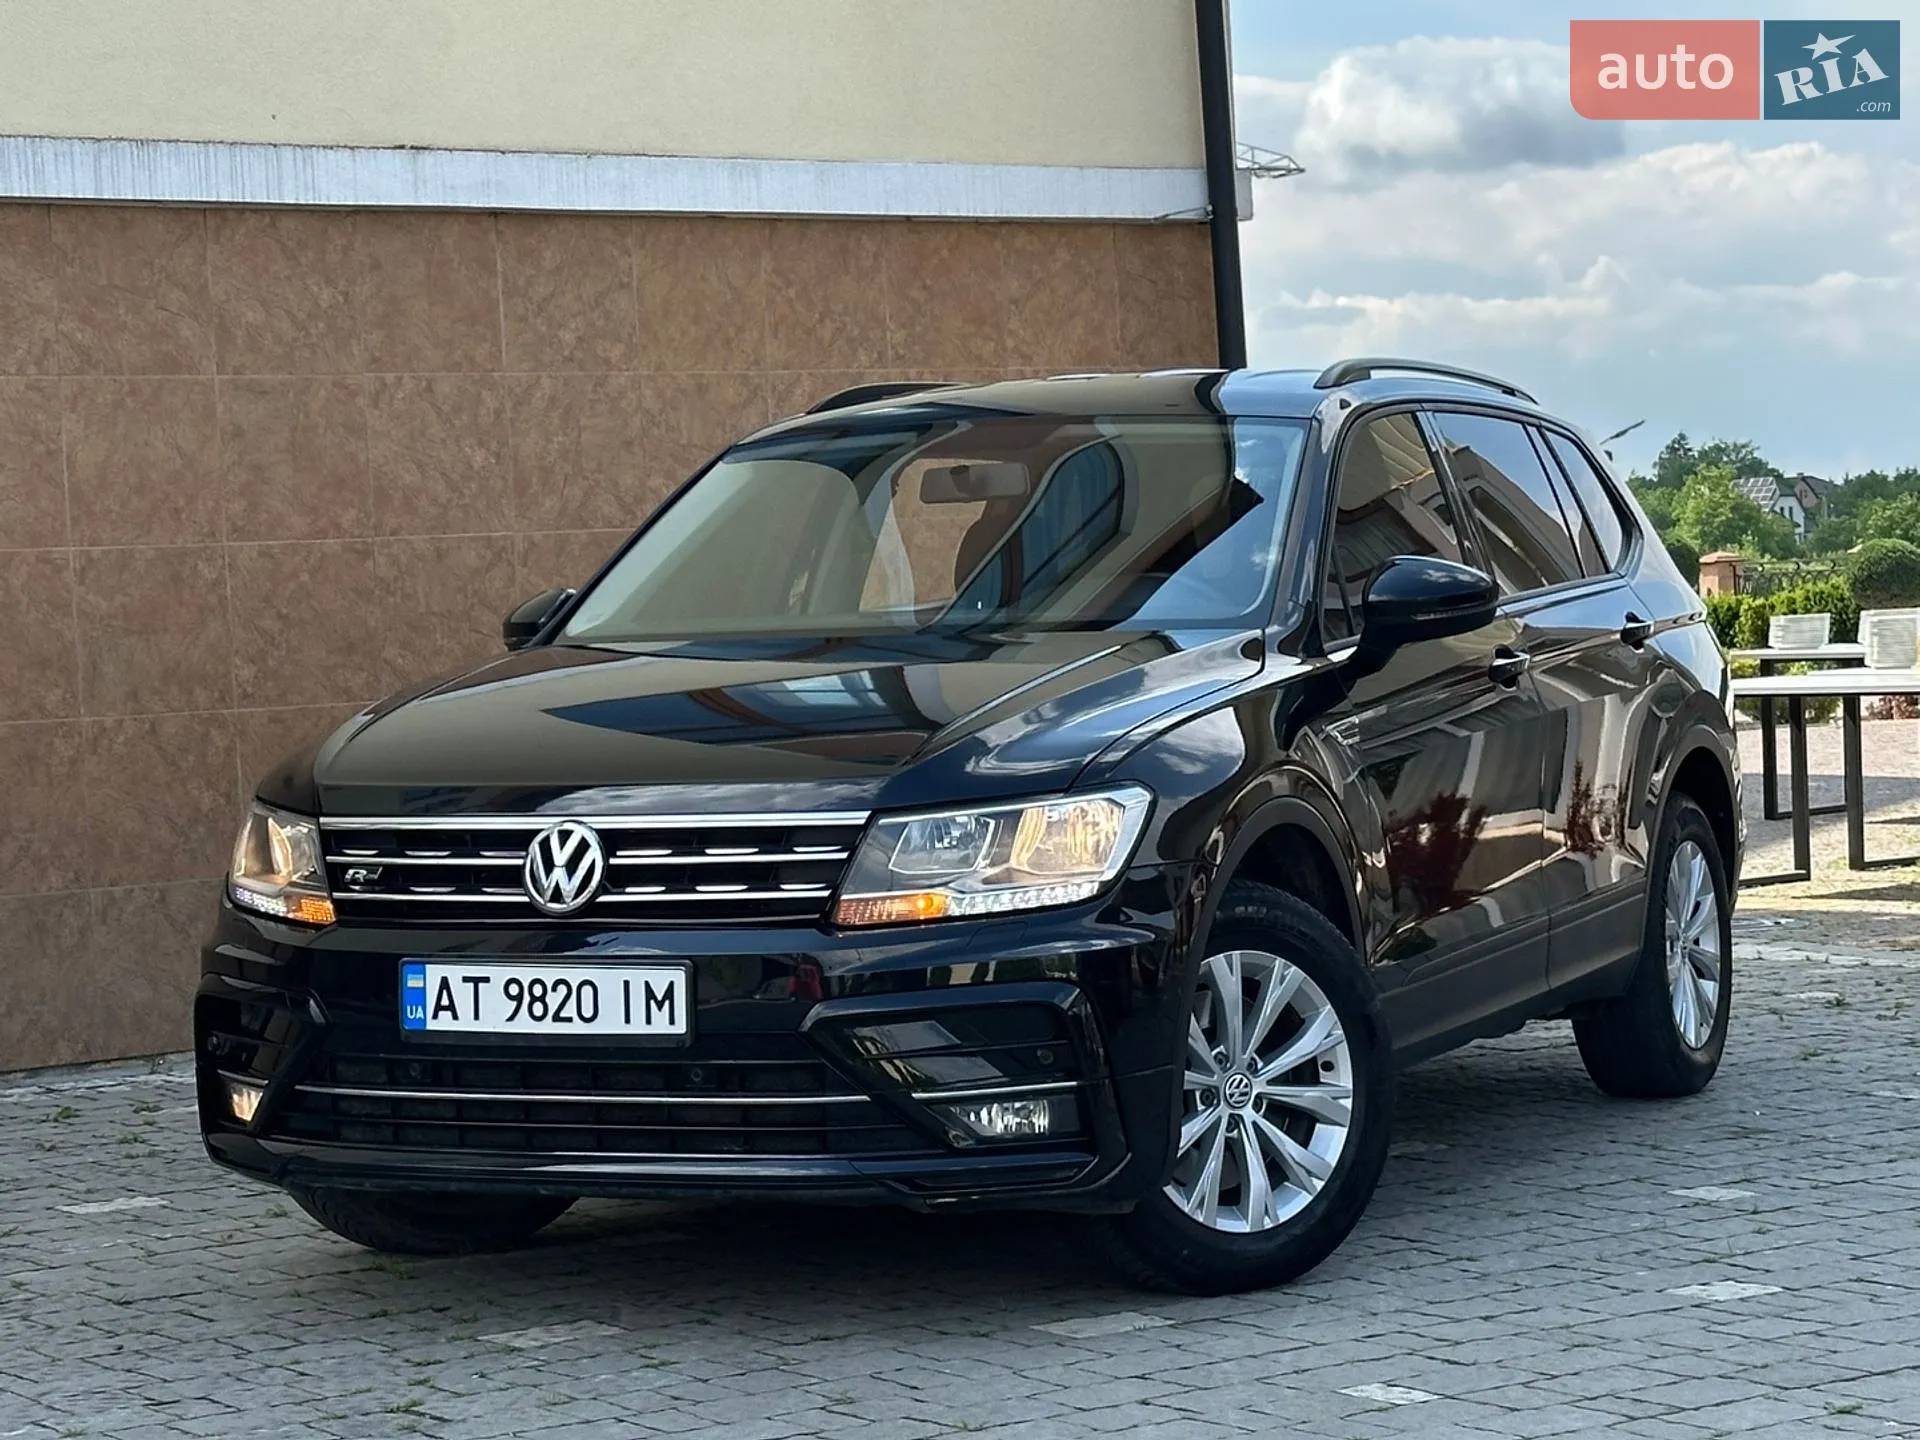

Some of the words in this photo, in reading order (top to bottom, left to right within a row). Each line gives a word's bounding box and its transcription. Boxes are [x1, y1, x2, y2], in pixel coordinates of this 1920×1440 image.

[406, 1004, 425, 1020] UA
[431, 976, 491, 1021] AT
[502, 977, 600, 1024] 9820
[622, 979, 676, 1026] IM
